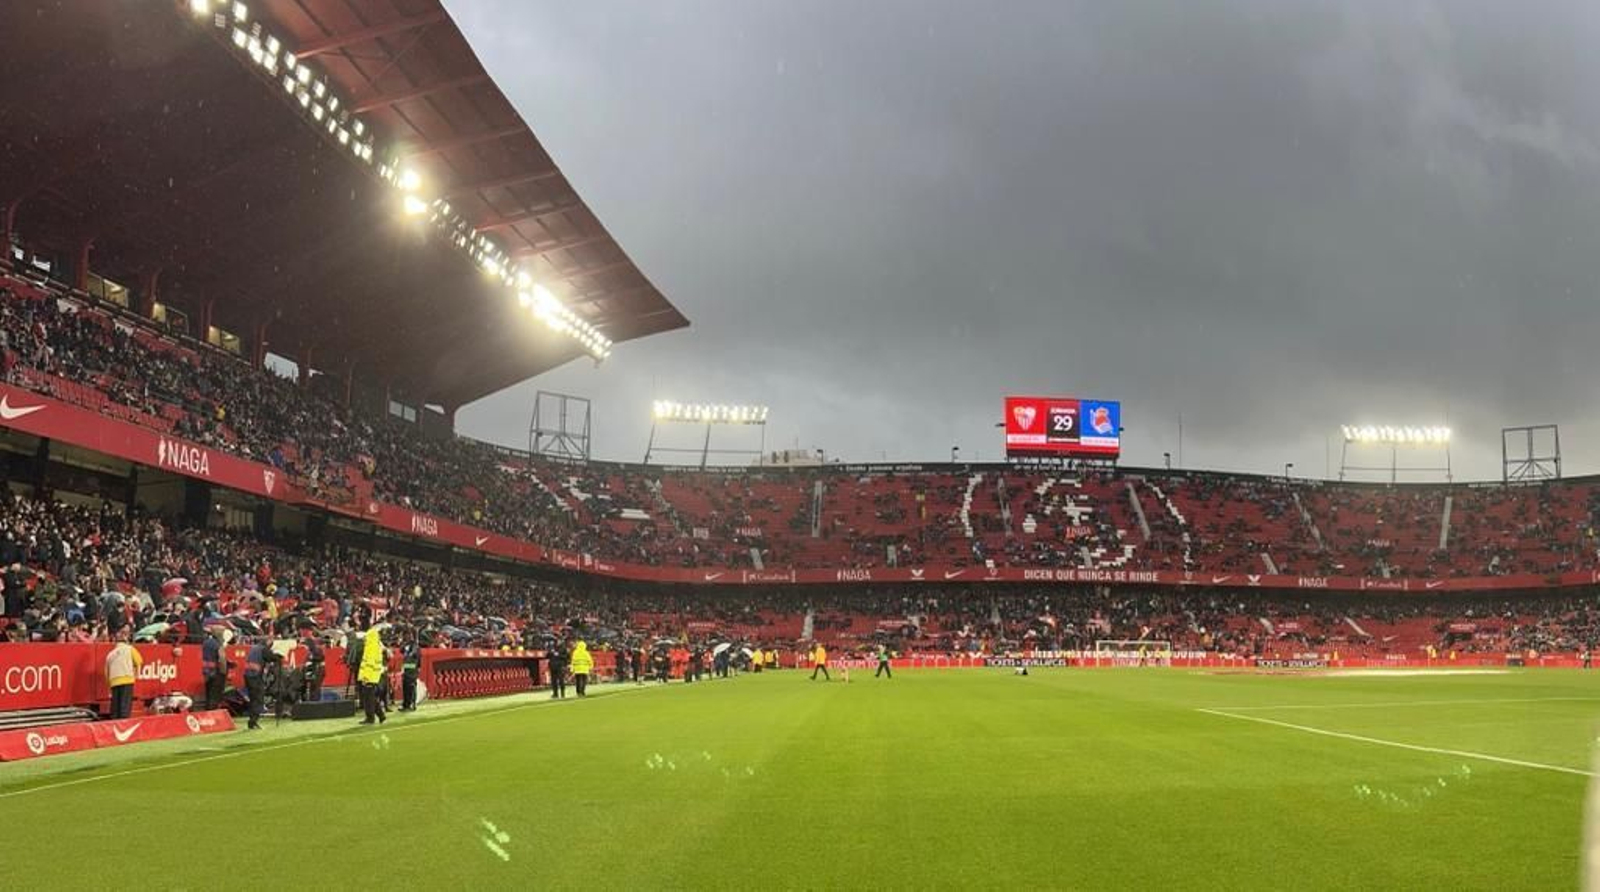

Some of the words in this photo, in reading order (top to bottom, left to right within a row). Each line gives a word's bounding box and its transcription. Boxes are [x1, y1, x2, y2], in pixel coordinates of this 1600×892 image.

[1053, 415, 1073, 431] 29
[167, 439, 210, 476] NAGA
[416, 514, 438, 538] NAGA
[841, 570, 871, 582] NAGA
[1024, 569, 1052, 580] DICEN
[1055, 569, 1076, 580] QUE
[1078, 570, 1111, 581] NUNCA
[1114, 571, 1127, 581] SE
[1129, 571, 1159, 582] RINDE
[0, 664, 62, 694] .com
[138, 660, 177, 683] LaLiga
